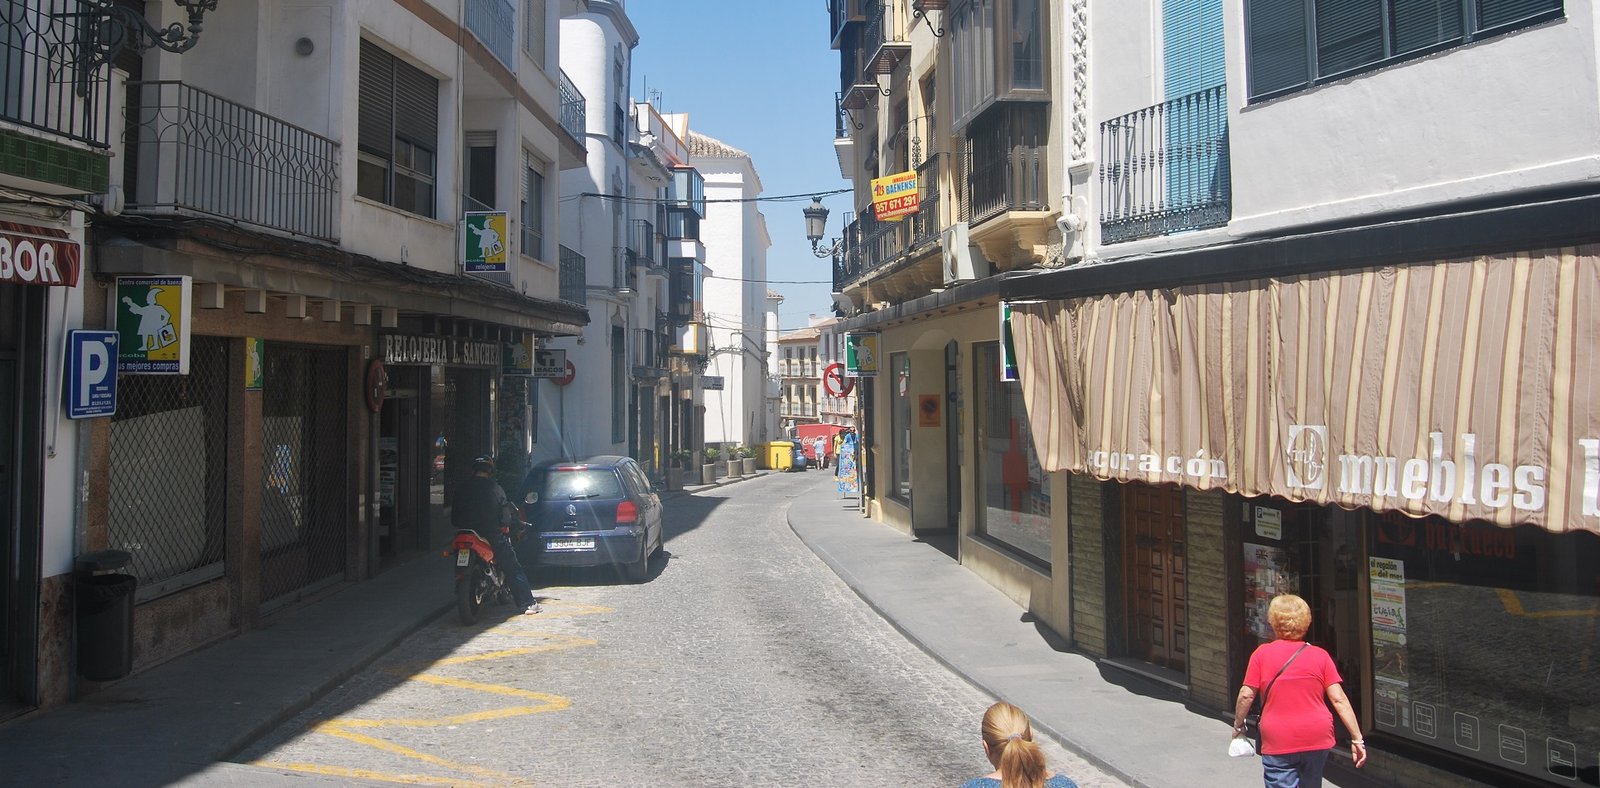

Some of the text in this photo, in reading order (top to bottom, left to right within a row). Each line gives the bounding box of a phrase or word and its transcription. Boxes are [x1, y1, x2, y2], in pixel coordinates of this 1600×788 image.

[886, 180, 916, 195] BAENENSE
[875, 194, 917, 213] 957 671 291
[385, 334, 448, 364] RELOJERIA
[81, 341, 109, 406] P
[126, 361, 151, 372] mejores
[152, 362, 179, 372] compras
[1337, 431, 1545, 511] muebles
